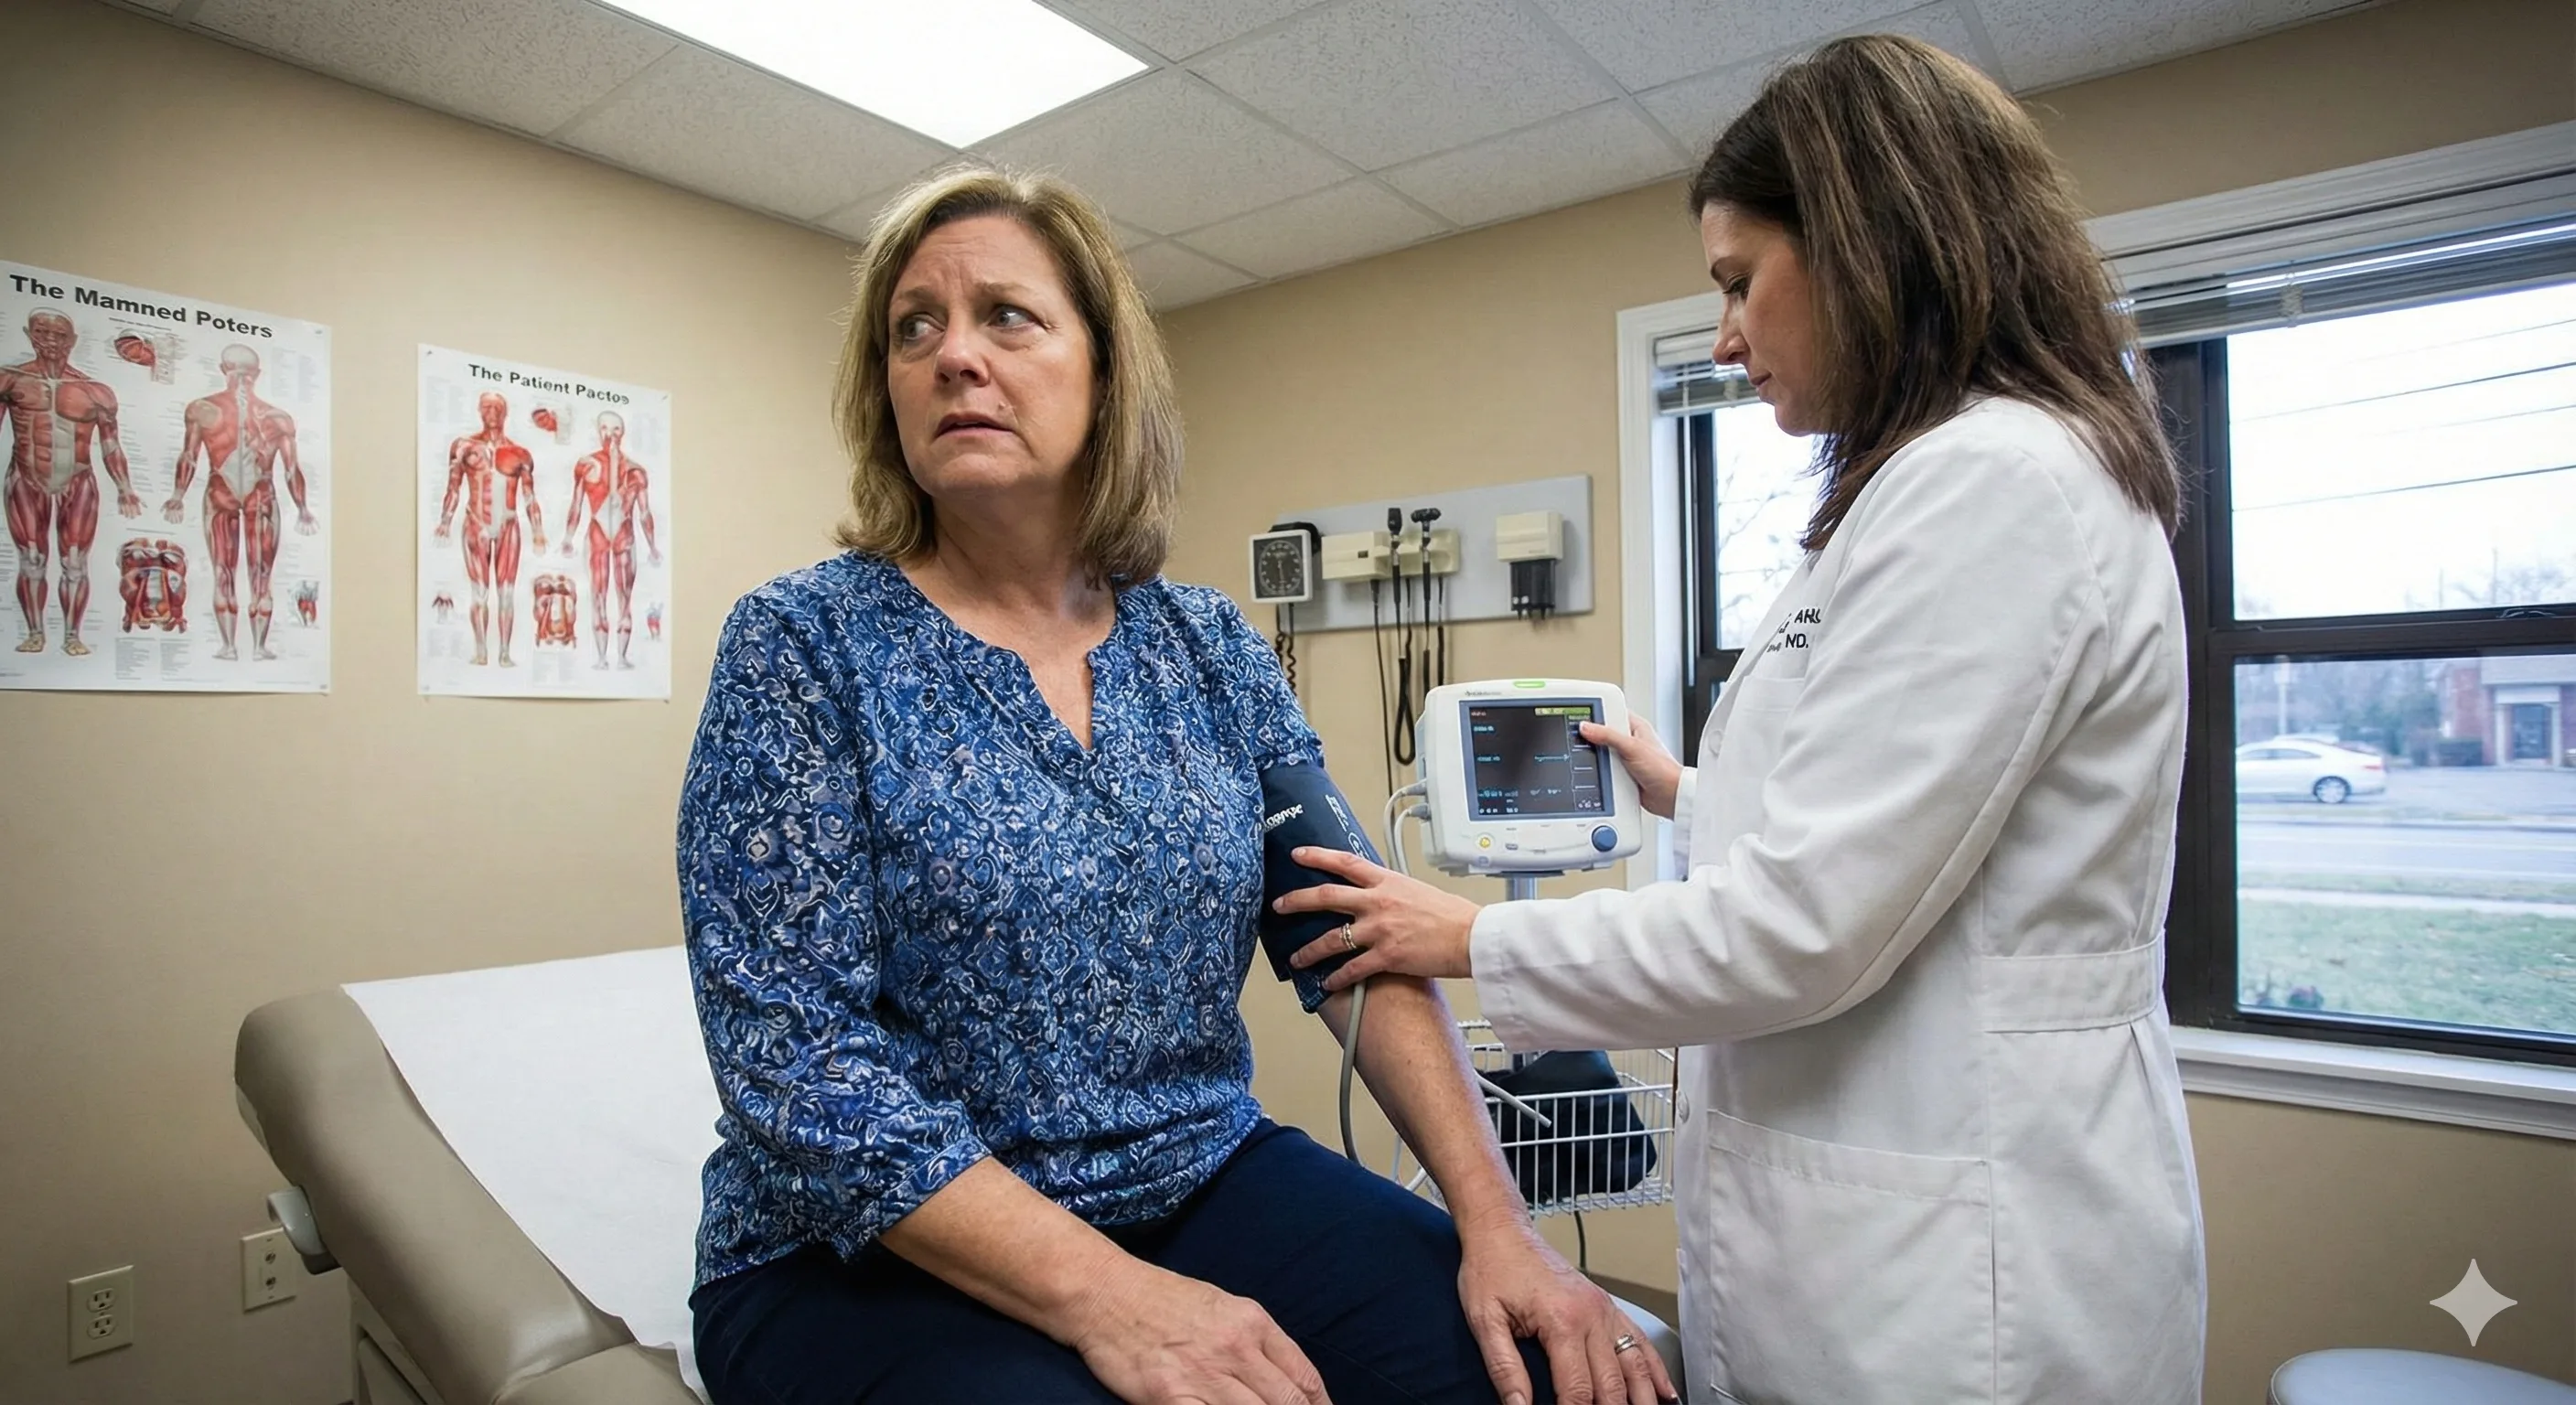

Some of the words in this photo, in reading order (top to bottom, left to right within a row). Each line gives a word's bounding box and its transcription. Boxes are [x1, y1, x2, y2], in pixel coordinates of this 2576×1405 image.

[9, 274, 65, 299] The
[74, 286, 187, 323] Mamned
[196, 310, 273, 338] Poters
[467, 363, 503, 381] The
[510, 371, 570, 394] Patient
